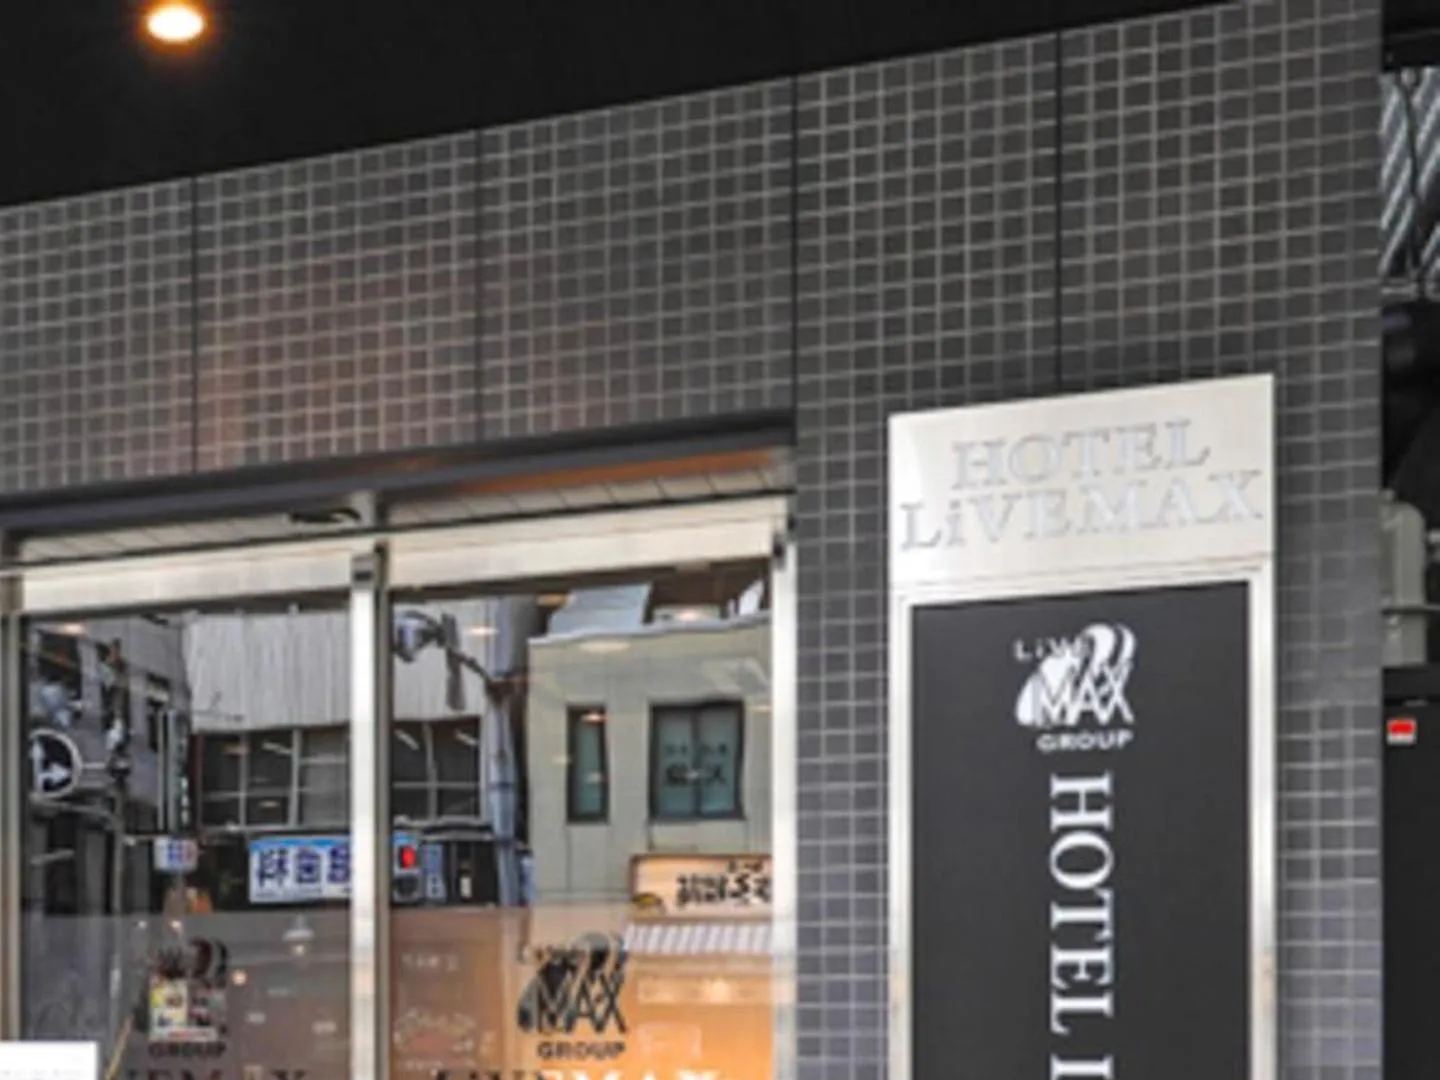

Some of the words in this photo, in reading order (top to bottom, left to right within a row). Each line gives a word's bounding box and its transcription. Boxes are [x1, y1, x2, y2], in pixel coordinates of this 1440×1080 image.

[951, 418, 1211, 490] HOTEL
[899, 470, 1264, 551] LiVEMAX
[1032, 664, 1135, 726] MAX
[1036, 729, 1134, 754] GROUP
[1049, 771, 1114, 1034] HOTEL
[537, 1039, 626, 1060] GROUP
